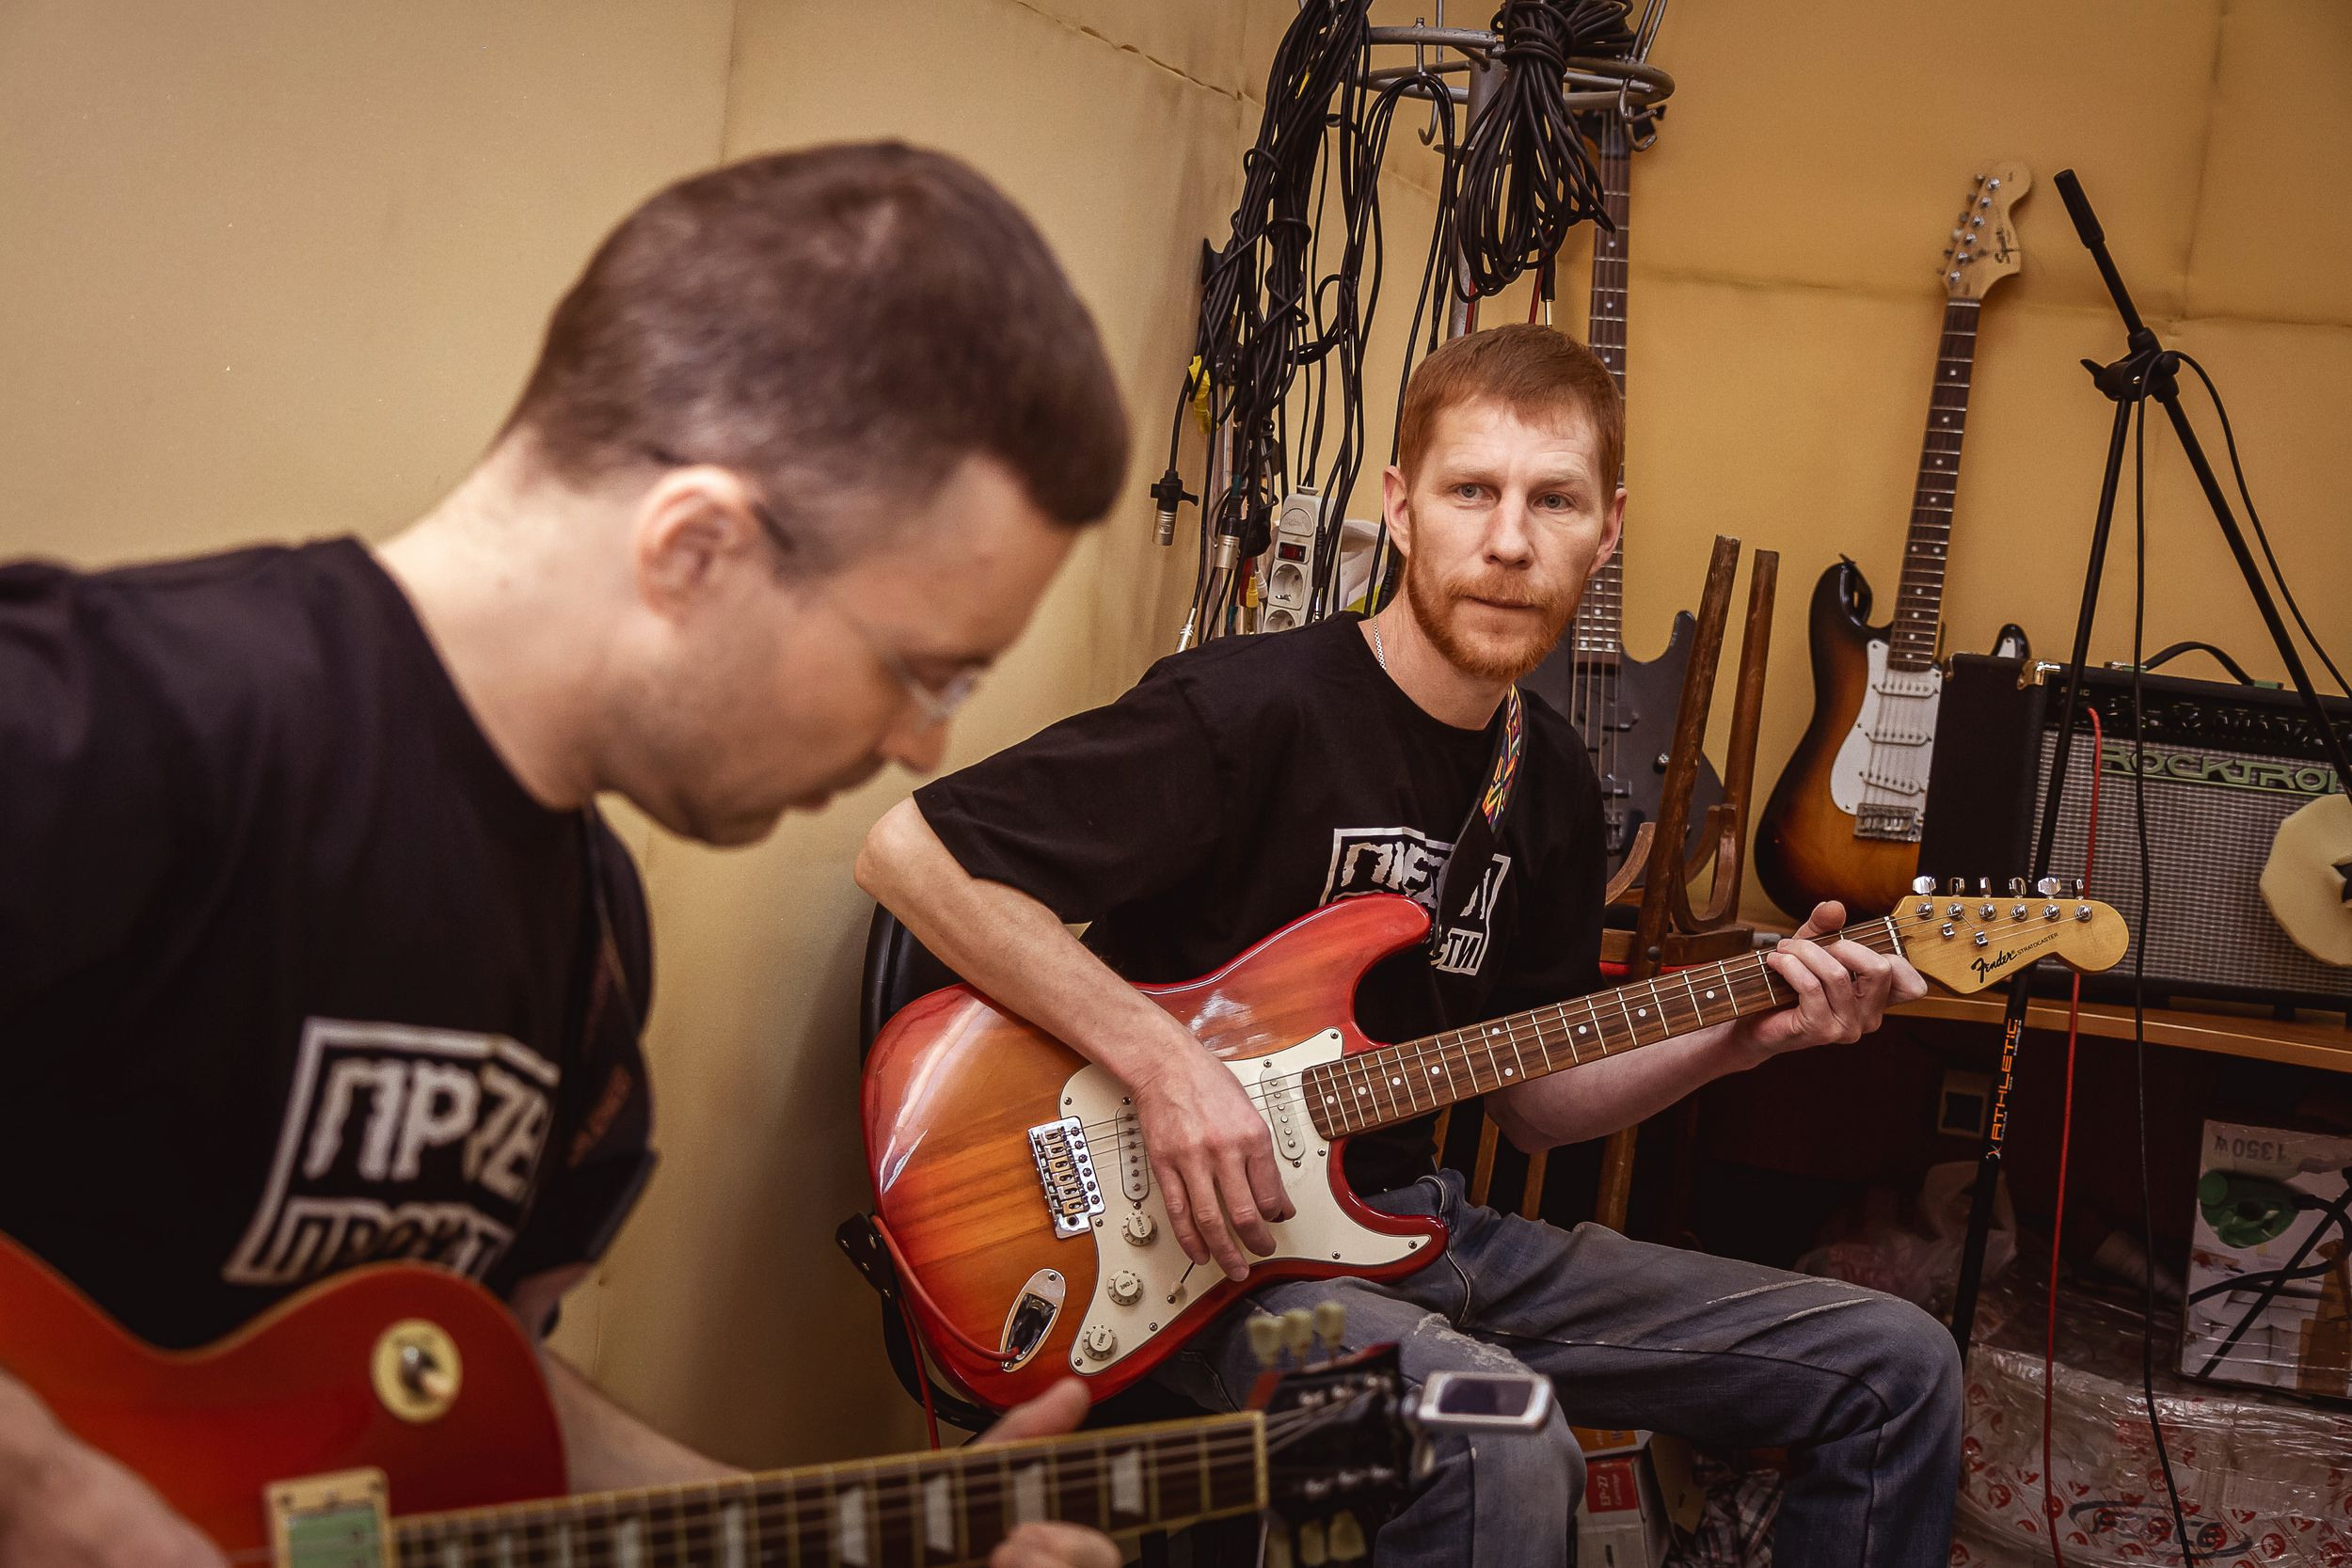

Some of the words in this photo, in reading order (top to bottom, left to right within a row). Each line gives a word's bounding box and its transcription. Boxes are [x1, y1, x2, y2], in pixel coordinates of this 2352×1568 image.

[2016, 931, 2058, 957] STRATOCASTER
[2232, 1139, 2287, 1160] 1350
[1119, 1279, 1134, 1291] TONE
[1096, 1333, 1106, 1346] TONE
[1597, 1475, 1611, 1505] EP-27
